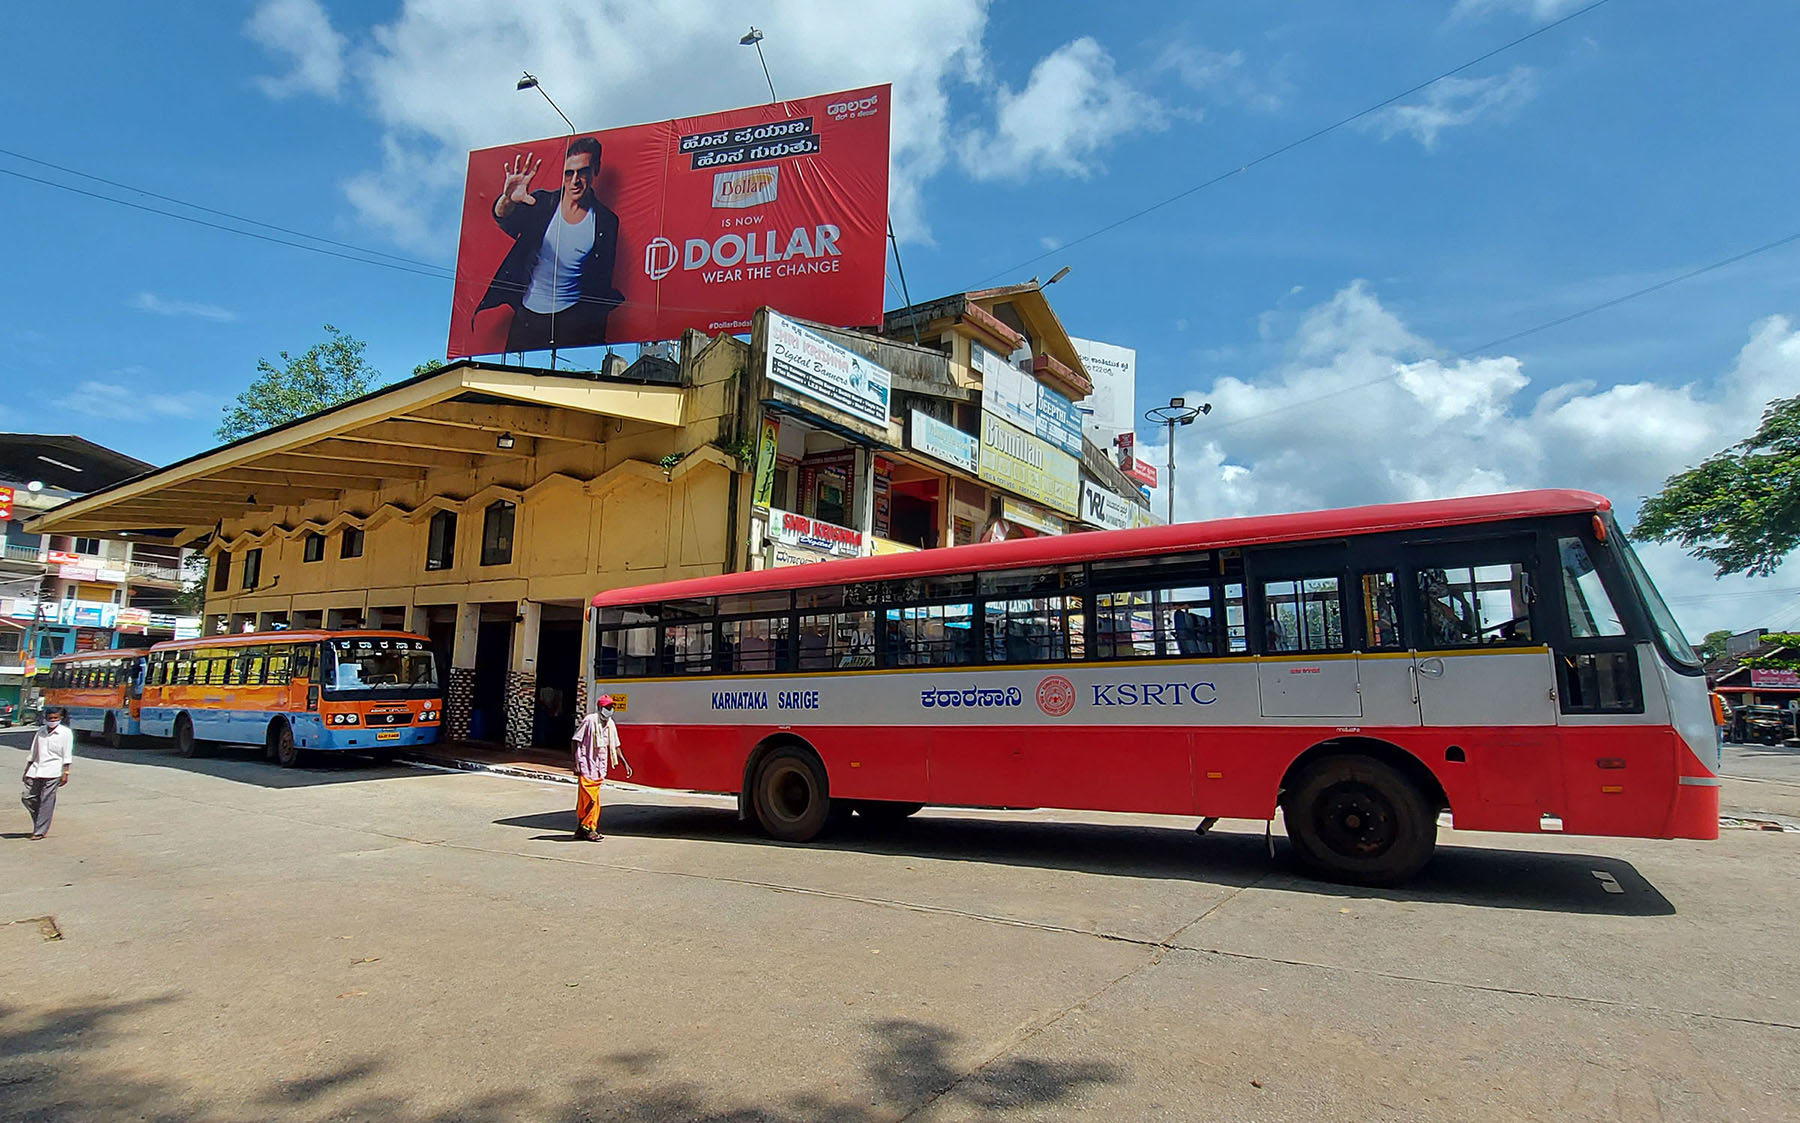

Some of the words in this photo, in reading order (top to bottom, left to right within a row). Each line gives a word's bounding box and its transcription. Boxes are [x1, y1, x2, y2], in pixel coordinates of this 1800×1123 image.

[682, 131, 730, 151] ಹೊಸ
[734, 121, 811, 144] ಪ್ರಯಾಣ.
[697, 149, 744, 167] ಹೊಸ
[750, 139, 819, 159] ಗುರುತು.
[722, 179, 767, 197] Dollar
[721, 218, 731, 228] IS
[735, 215, 764, 227] NOW
[683, 223, 842, 271] DOLLAR
[702, 269, 743, 284] WEAR
[747, 266, 772, 279] THE
[776, 260, 840, 277] CHANGE
[774, 343, 810, 368] Digital
[813, 361, 848, 386] Banners
[1038, 397, 1067, 424] DEEPTHI
[984, 413, 1043, 470] Bismillah
[783, 513, 810, 535] SHRI
[799, 535, 833, 549] Digital
[711, 691, 768, 710] KARNATAKA
[778, 690, 819, 709] SARIGE
[920, 683, 1022, 708] ಕರಾರಸಾನಿ
[1092, 682, 1217, 706] KSRTC
